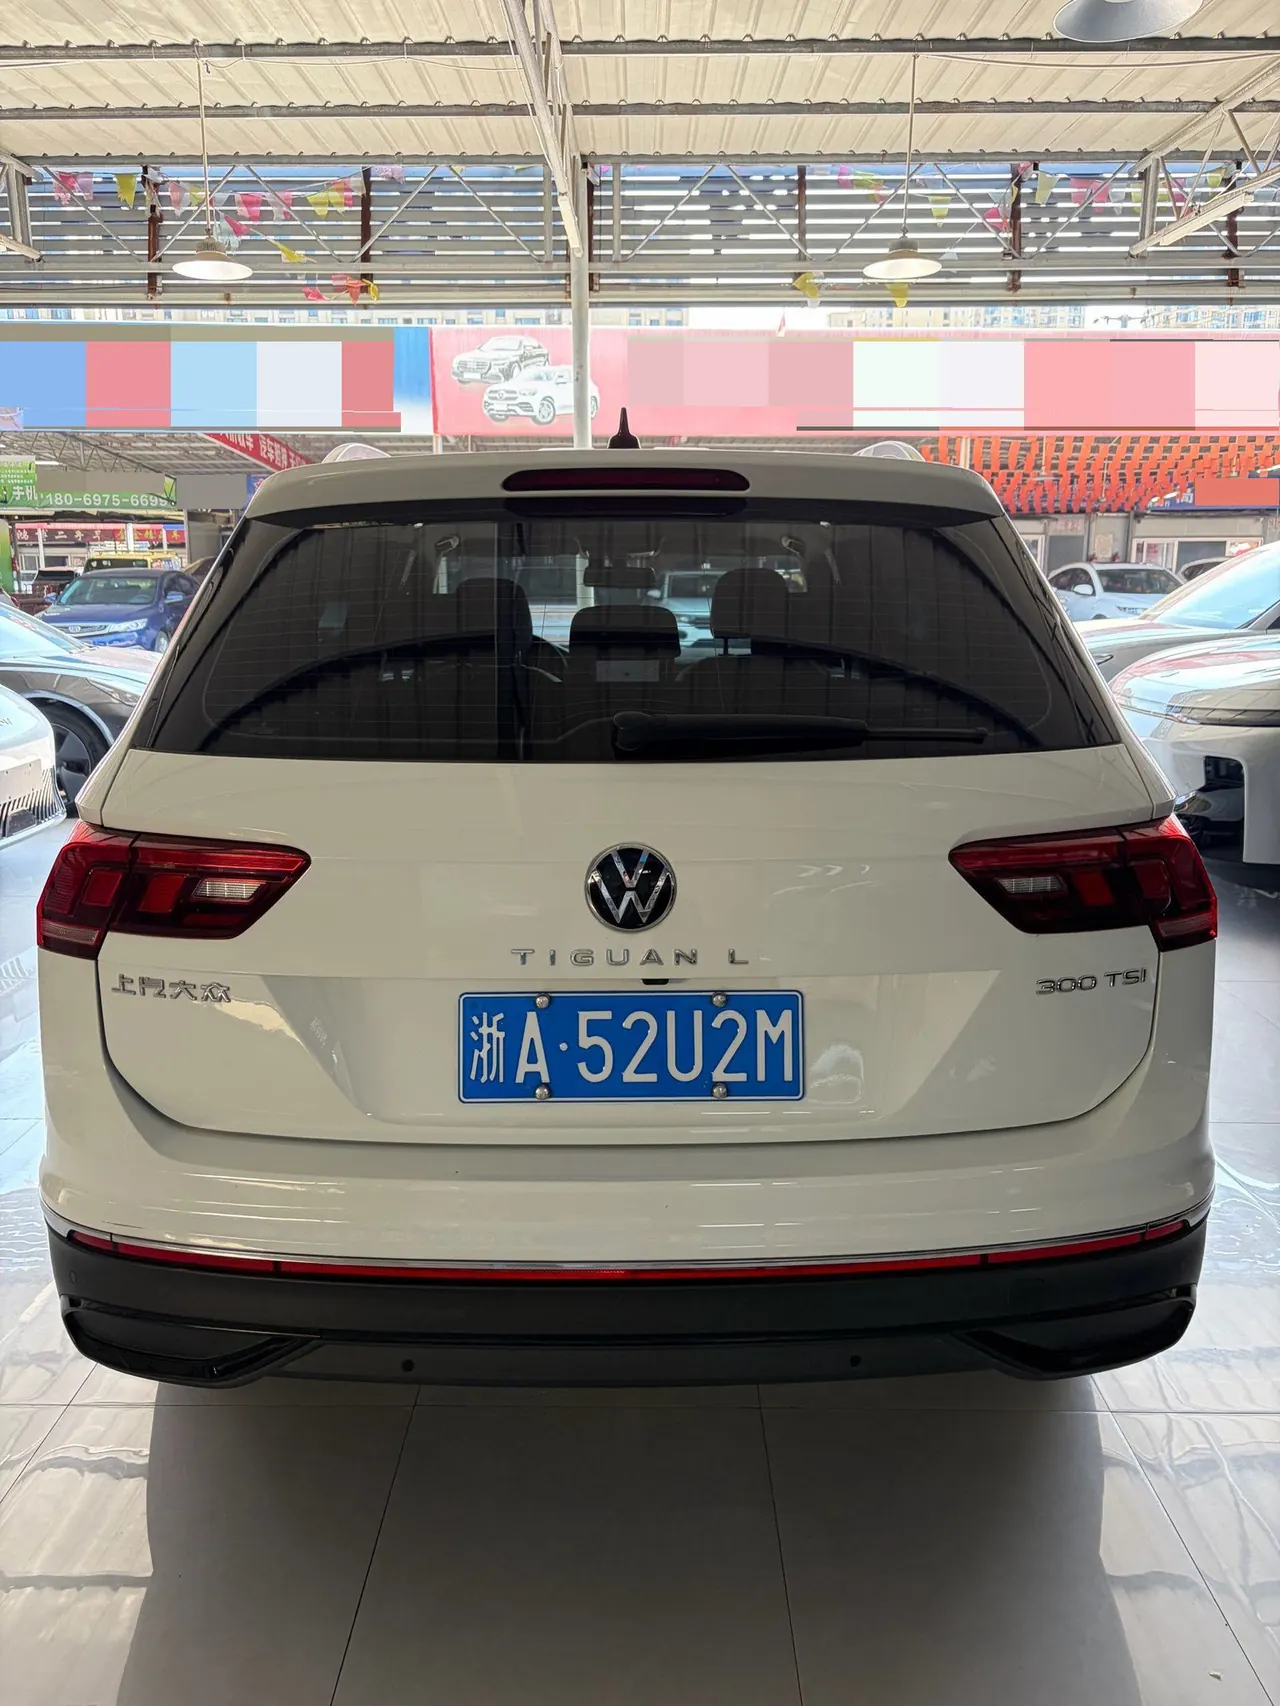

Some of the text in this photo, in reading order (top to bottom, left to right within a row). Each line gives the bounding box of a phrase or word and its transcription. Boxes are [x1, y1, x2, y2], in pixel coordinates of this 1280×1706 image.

[511, 948, 750, 967] TIGUAN L
[111, 973, 231, 1003] 上汽大众
[1036, 967, 1147, 995] 300 TSI
